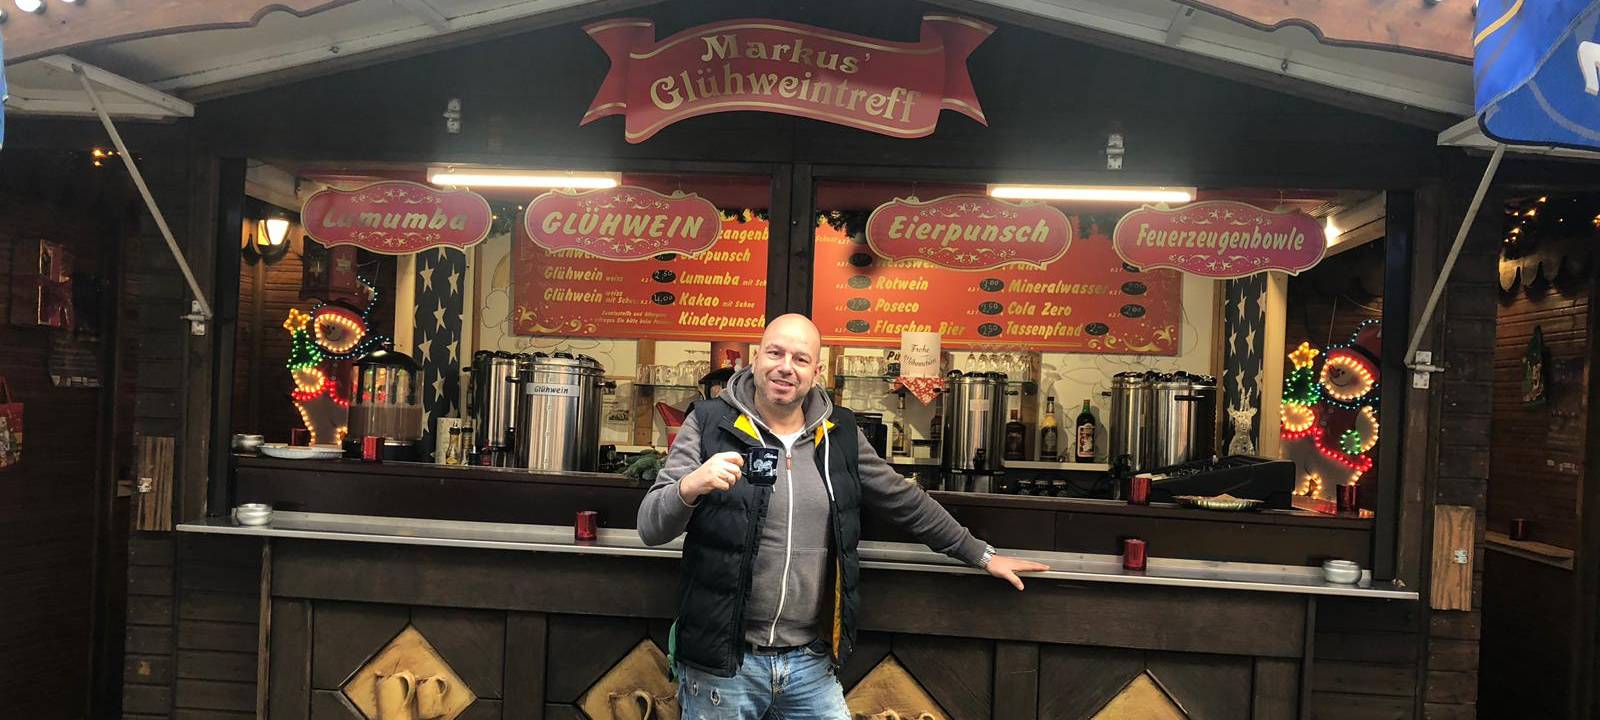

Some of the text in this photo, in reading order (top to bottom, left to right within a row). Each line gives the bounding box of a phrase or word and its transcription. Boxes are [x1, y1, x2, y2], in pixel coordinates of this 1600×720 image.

[701, 34, 873, 75] Markus'
[649, 63, 925, 124] Glühweintreff
[321, 204, 469, 232] Lumumba
[541, 206, 705, 241] GLÜHWEIN
[887, 216, 1051, 249] Eierpunsch
[1135, 221, 1306, 255] Feuerzeugenbowle
[543, 266, 604, 283] Glühwein
[680, 271, 741, 286] Lumumba
[876, 275, 929, 291] Rotwein
[543, 287, 603, 303] Glühwein
[678, 291, 721, 306] Kakao
[875, 298, 920, 313] Poseco
[1007, 301, 1036, 317] Cola
[1041, 302, 1073, 317] Zero
[678, 311, 766, 330] Kinderpunsch
[874, 320, 932, 336] Flaschen
[939, 321, 966, 336] Bier
[1006, 321, 1083, 340] Tassenpfand
[535, 385, 569, 395] Glühwein
